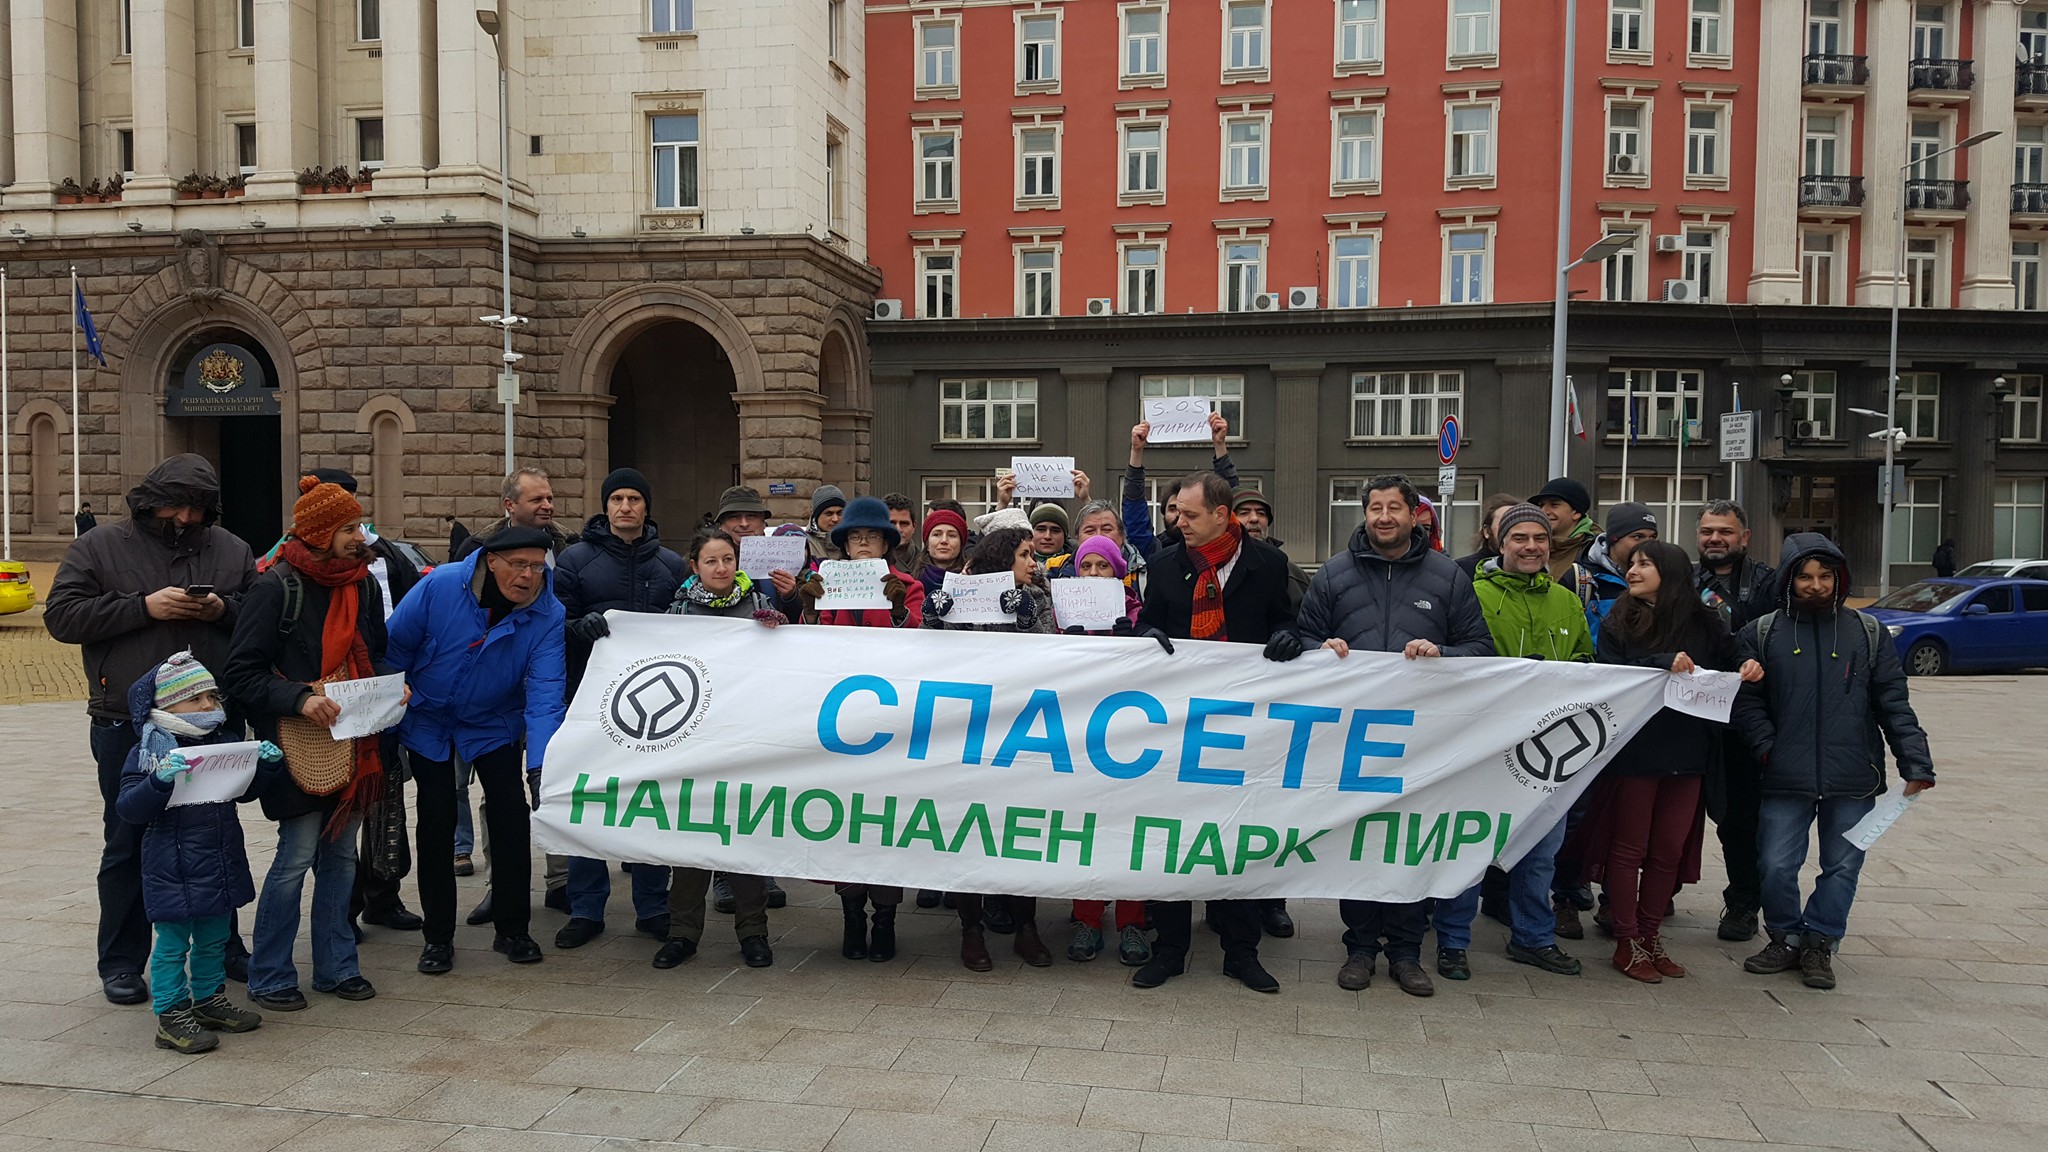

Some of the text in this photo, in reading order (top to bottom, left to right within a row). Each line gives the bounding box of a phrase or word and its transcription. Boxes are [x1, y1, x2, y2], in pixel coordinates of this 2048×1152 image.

[1150, 420, 1207, 437] ПИРИН
[1016, 463, 1066, 474] ПИРИН
[1015, 482, 1072, 495] БАНИЦА
[953, 587, 978, 597] ШУТ
[1055, 585, 1093, 597] ИСКАМ
[1061, 596, 1097, 607] ПИРИН
[625, 653, 710, 678] PATRIMONIO MUNDIAL
[332, 680, 380, 696] ПИРИН
[1670, 680, 1726, 708] ПИРИН
[635, 687, 713, 753] PATRIMOINE MONDIAL
[1536, 702, 1593, 728] PATRIMONIO
[599, 711, 625, 747] HERITAGE
[817, 674, 1415, 794] СПАСЕТЕ
[201, 752, 251, 773] ПИРИН
[1503, 753, 1530, 787] HERITAGE
[570, 772, 1096, 867] НАЦИОНАЛЕН
[1129, 814, 1333, 875] ПАРК
